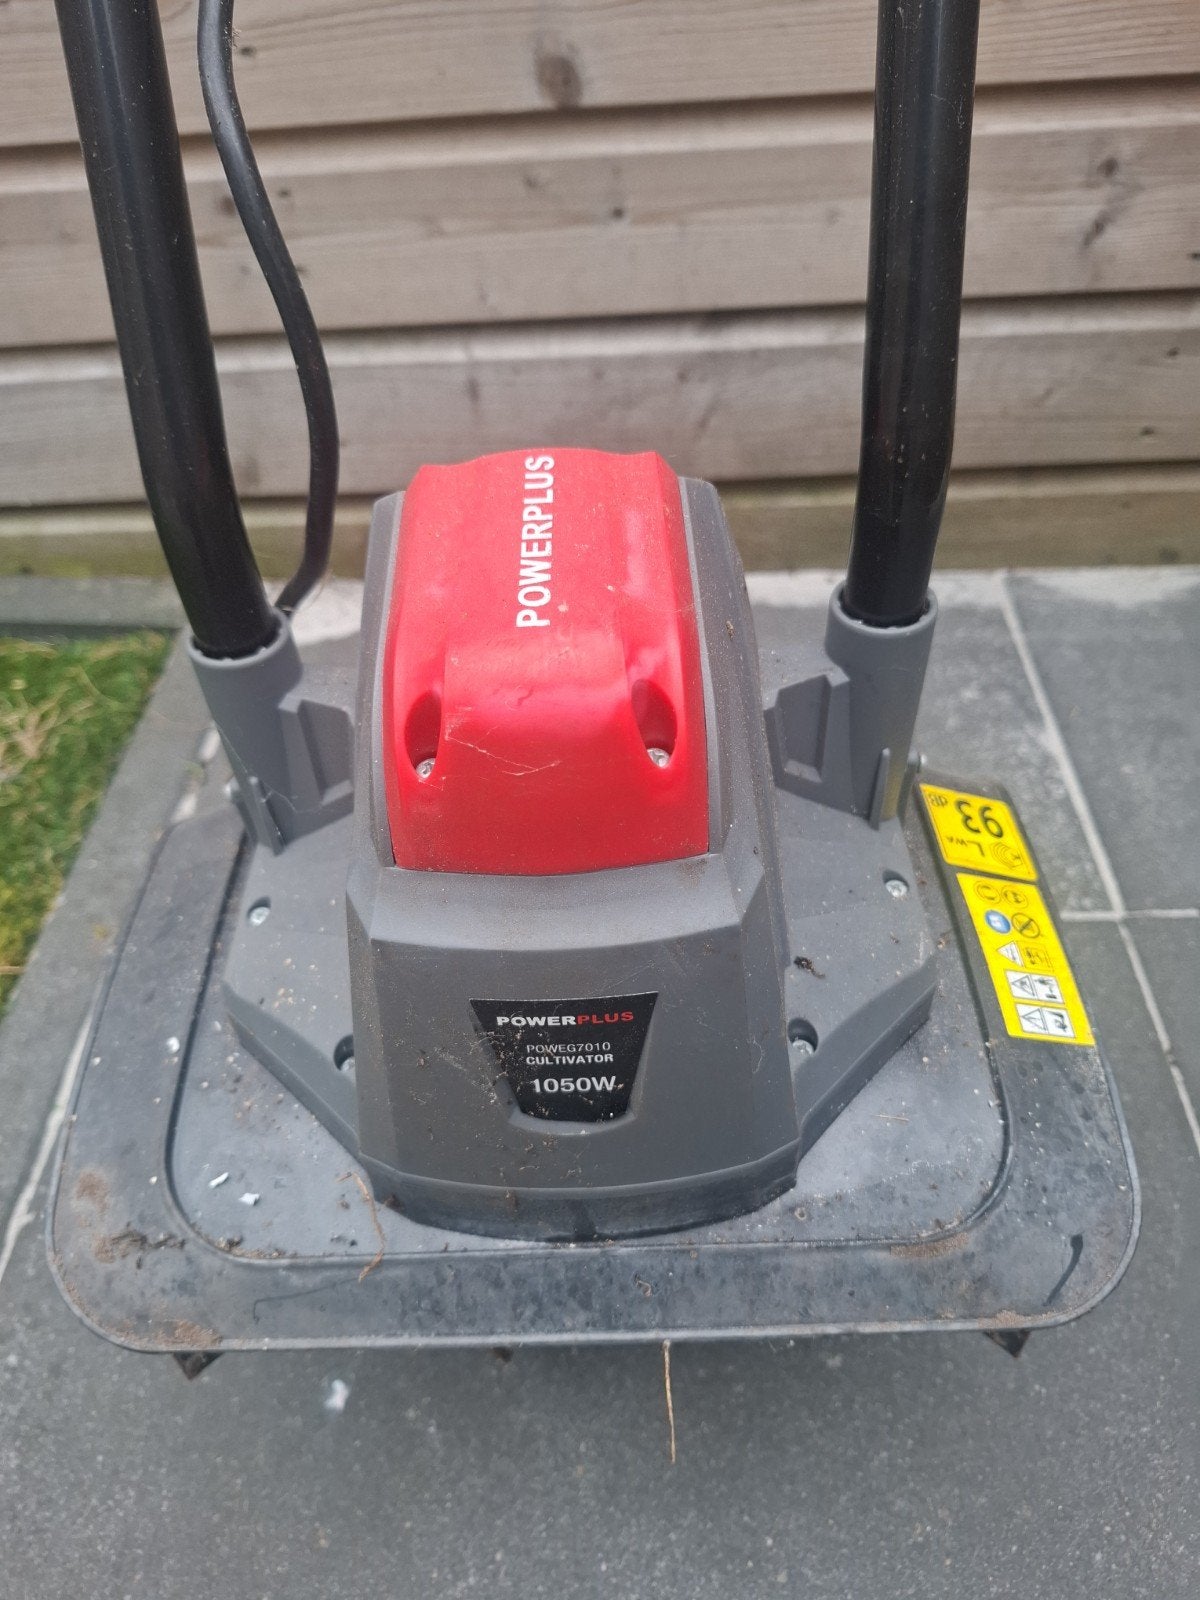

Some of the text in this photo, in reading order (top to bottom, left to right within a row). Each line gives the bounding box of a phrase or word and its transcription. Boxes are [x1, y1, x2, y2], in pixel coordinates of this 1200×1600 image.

[515, 455, 555, 628] POWERPLUS
[955, 800, 1004, 839] 93
[496, 1011, 634, 1026] POWERPLUS
[526, 1041, 611, 1054] POWEG7010
[526, 1053, 614, 1065] CULTIVATOR
[531, 1075, 616, 1094] 1050W
